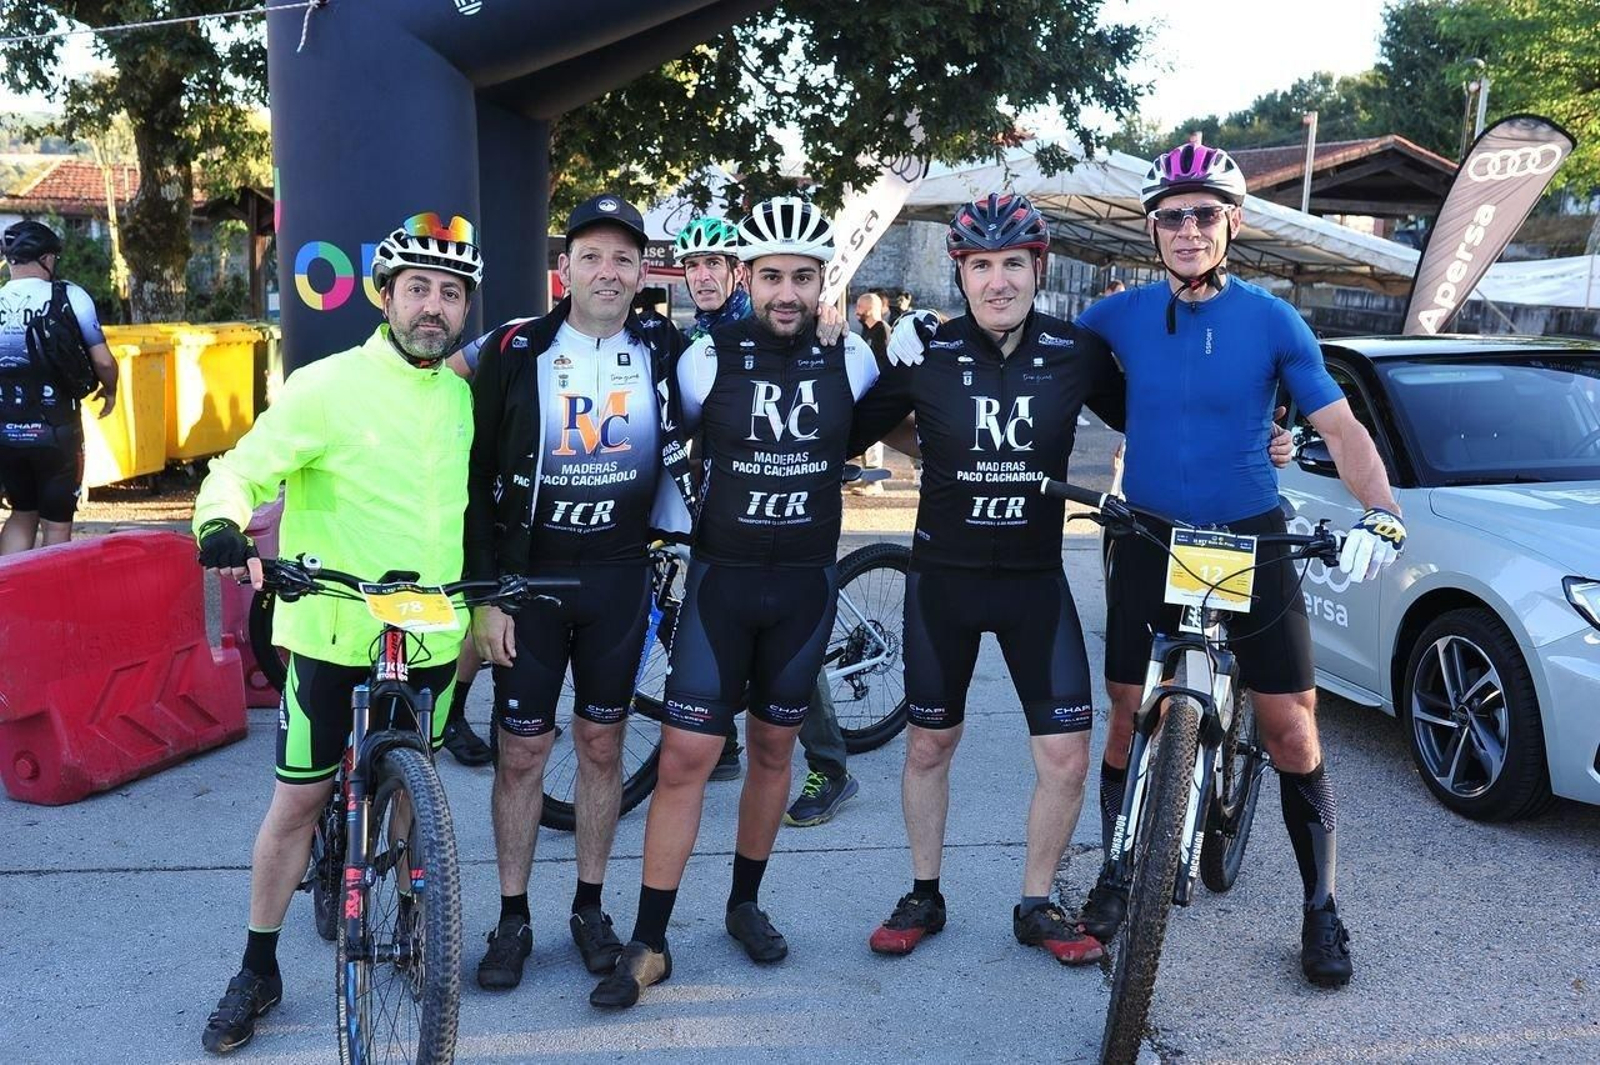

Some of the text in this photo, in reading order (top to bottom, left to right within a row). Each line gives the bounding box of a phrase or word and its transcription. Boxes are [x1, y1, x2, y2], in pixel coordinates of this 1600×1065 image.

[1418, 204, 1497, 335] Apersa
[754, 451, 809, 463] MADERAS
[561, 461, 618, 474] MADERAS
[732, 461, 828, 477] PACO CACHAROLO
[976, 461, 1026, 472] MADERAS
[540, 469, 637, 487] PACO CACHAROLO
[957, 471, 1044, 482] PACO CACHAROLO
[747, 491, 809, 517] TCR
[971, 496, 1026, 519] TCR
[551, 500, 616, 526] TCR
[1201, 565, 1223, 582] 12
[395, 601, 424, 615] 78
[667, 700, 709, 715] CHAPI
[909, 704, 946, 713] CHAPI
[1054, 704, 1091, 715] CHAPI
